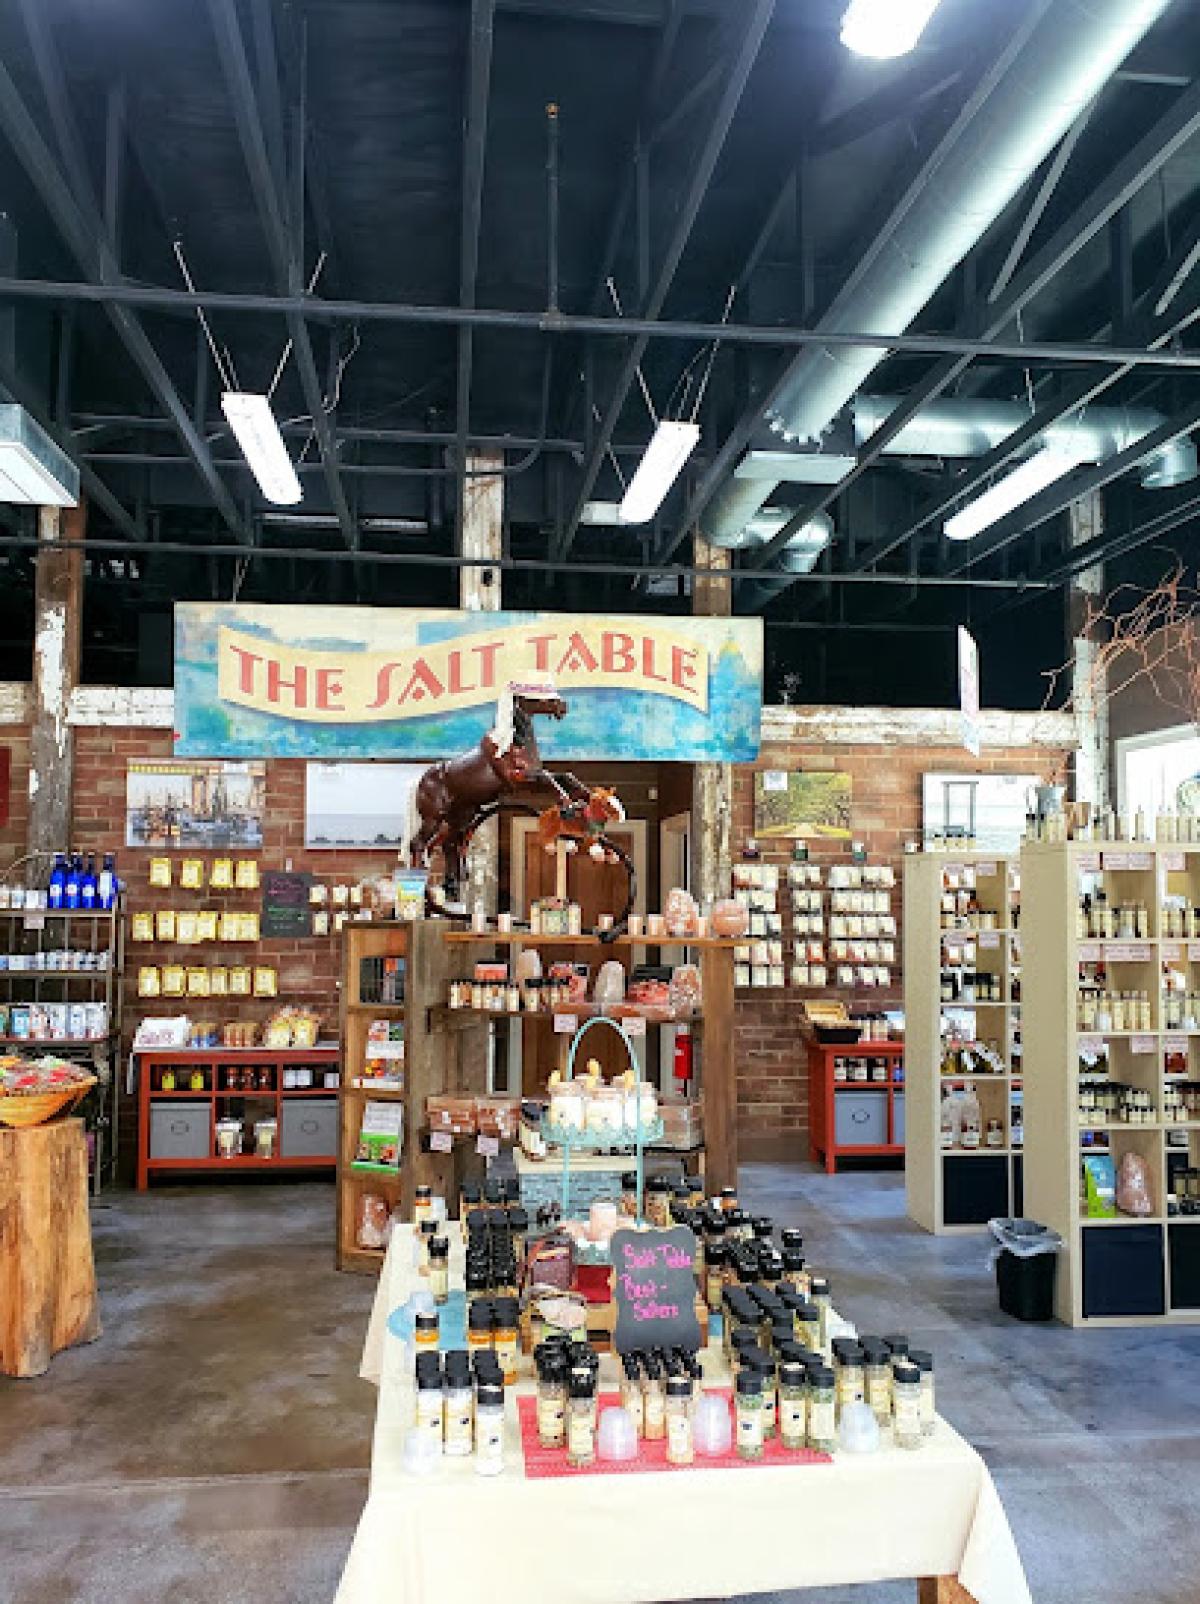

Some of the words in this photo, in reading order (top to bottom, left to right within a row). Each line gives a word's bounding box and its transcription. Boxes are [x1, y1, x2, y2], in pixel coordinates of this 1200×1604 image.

[229, 644, 346, 711] THE
[365, 642, 505, 708] SALT
[525, 630, 699, 696] TABLE
